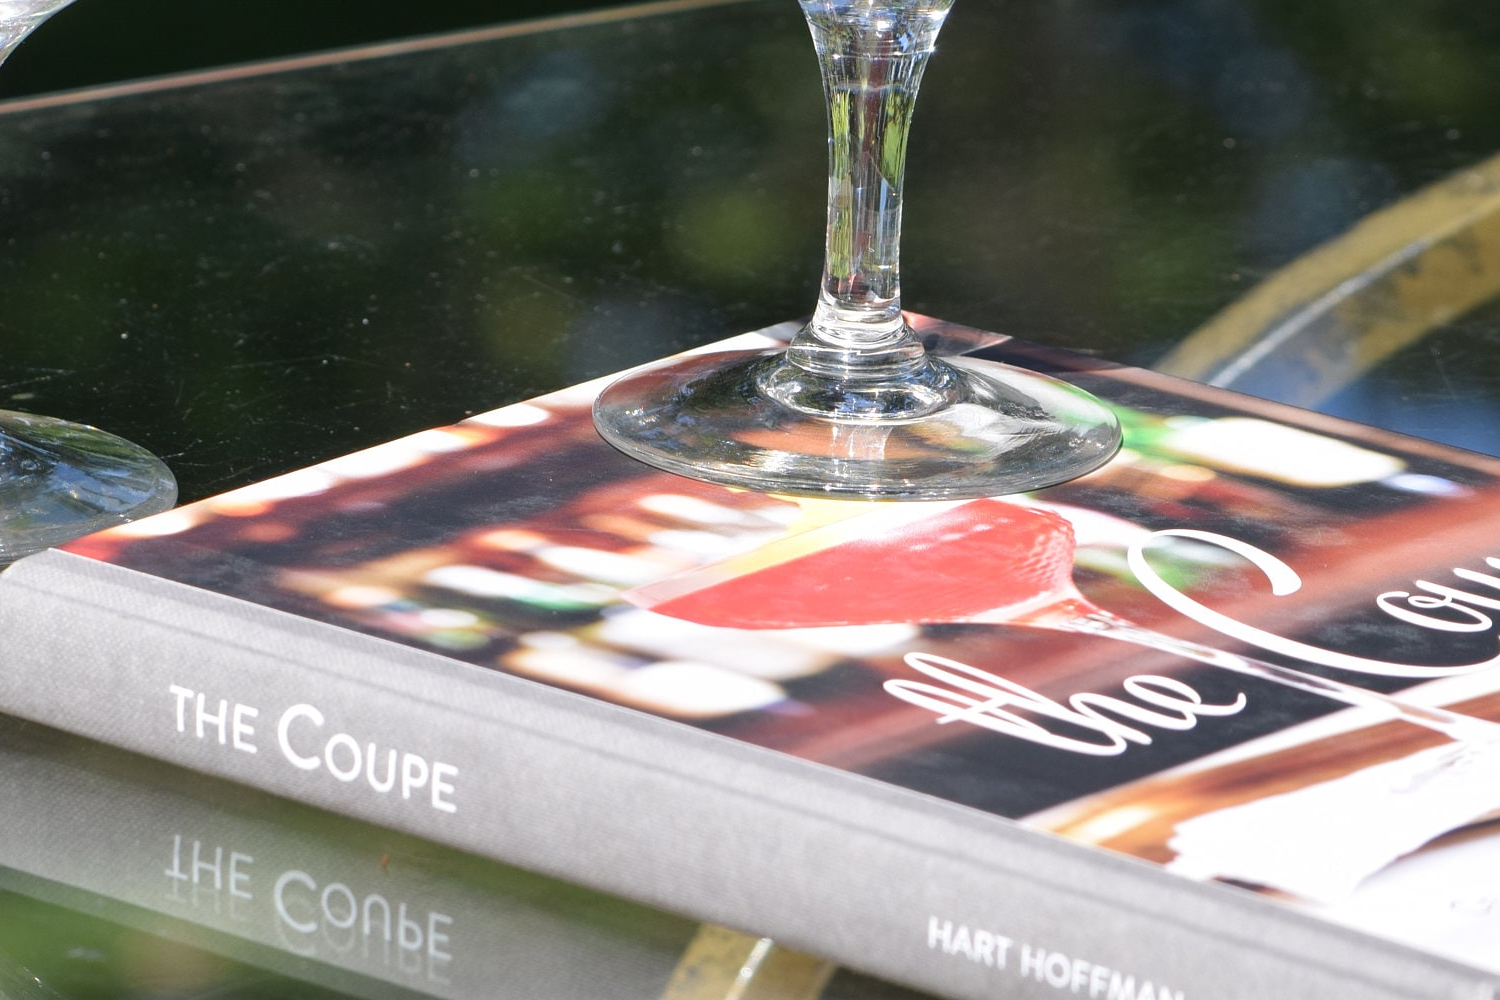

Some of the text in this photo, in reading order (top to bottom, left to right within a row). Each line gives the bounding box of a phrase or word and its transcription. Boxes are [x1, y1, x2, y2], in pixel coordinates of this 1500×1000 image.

[882, 528, 1500, 756] the Cou
[169, 684, 459, 814] THE COUPE
[928, 915, 1013, 970] HART
